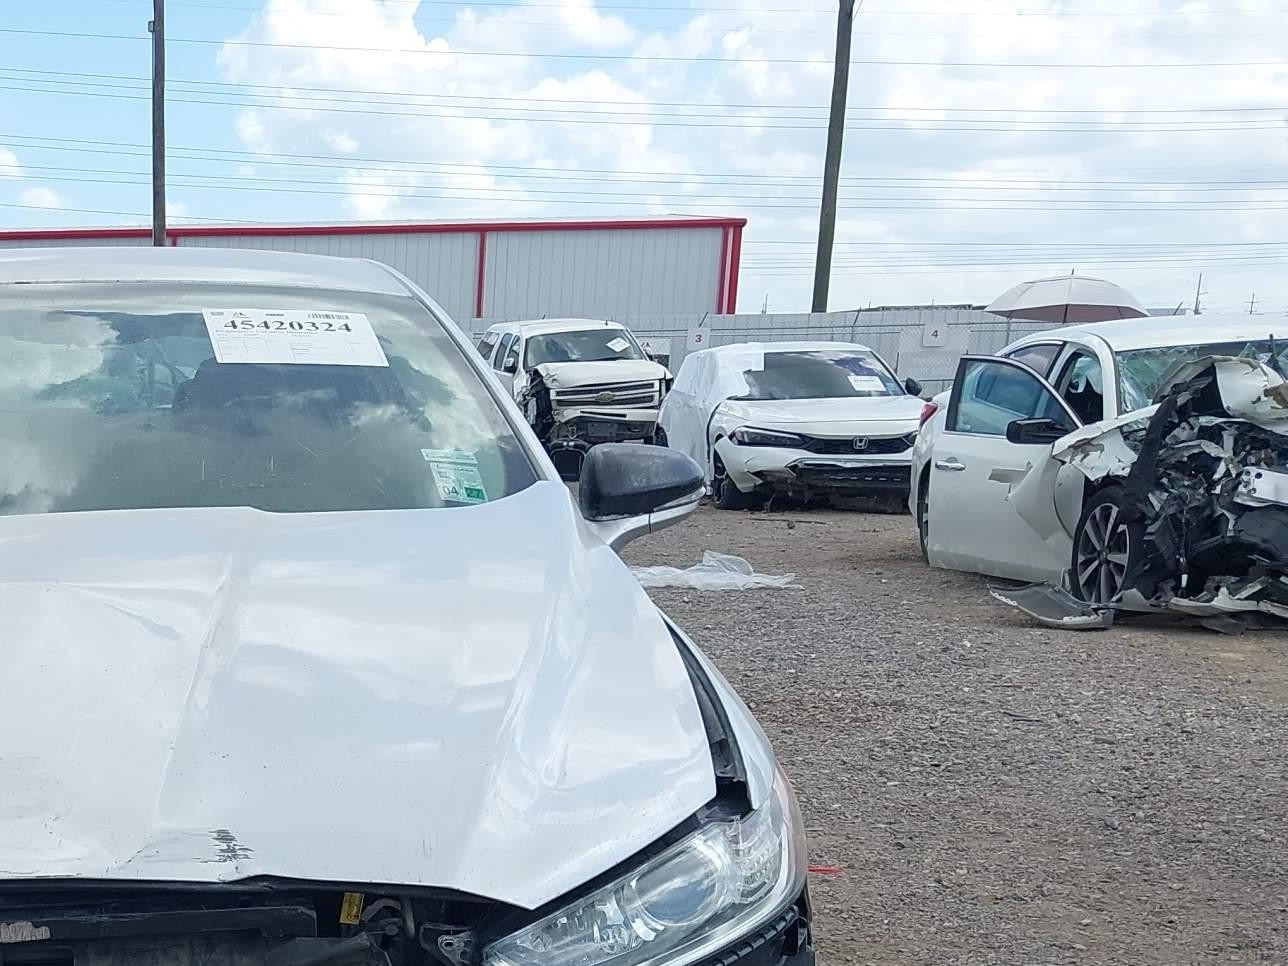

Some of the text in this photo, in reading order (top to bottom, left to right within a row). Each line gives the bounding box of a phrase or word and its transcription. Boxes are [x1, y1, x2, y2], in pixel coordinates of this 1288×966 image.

[223, 319, 353, 333] 45420324
[694, 334, 703, 343] 3
[931, 329, 939, 339] 4
[443, 486, 458, 495] 04
